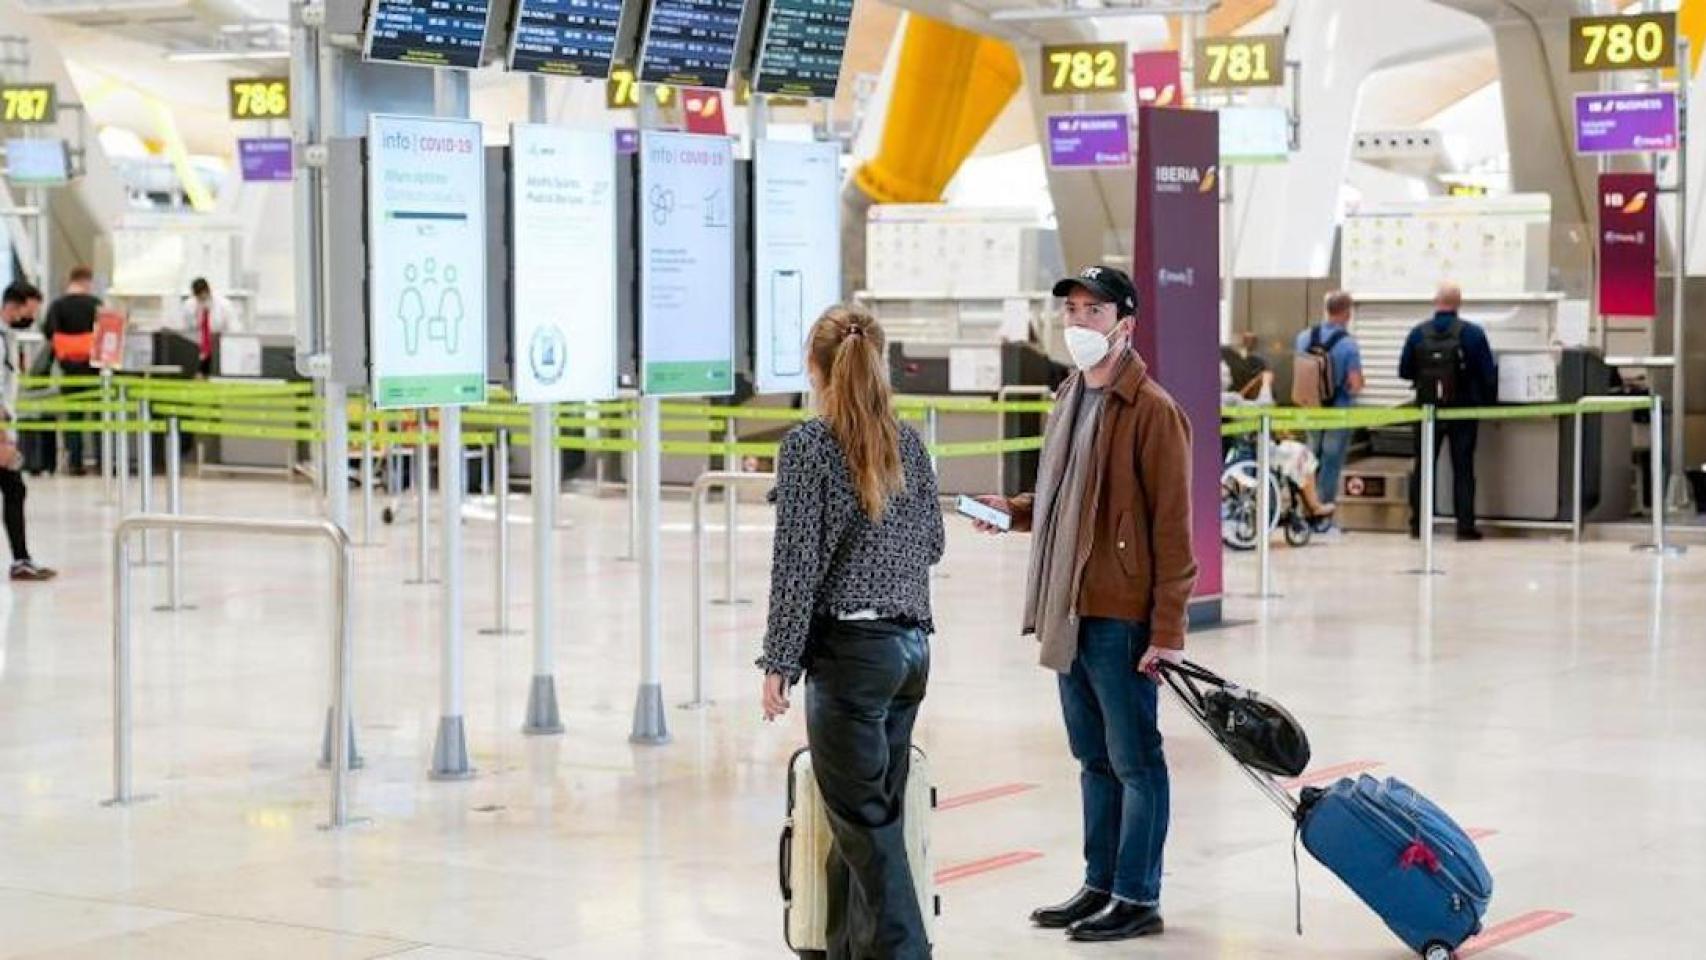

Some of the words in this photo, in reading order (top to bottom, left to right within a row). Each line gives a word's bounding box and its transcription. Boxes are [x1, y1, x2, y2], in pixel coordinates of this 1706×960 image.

[1581, 22, 1663, 64] 780
[1050, 50, 1117, 89] 782
[1206, 43, 1270, 82] 781
[2, 90, 48, 121] 787
[234, 82, 287, 116] 786
[382, 132, 411, 150] info
[420, 137, 473, 153] COVID-19
[1156, 165, 1201, 183] IBERIA
[1604, 192, 1624, 208] IB
